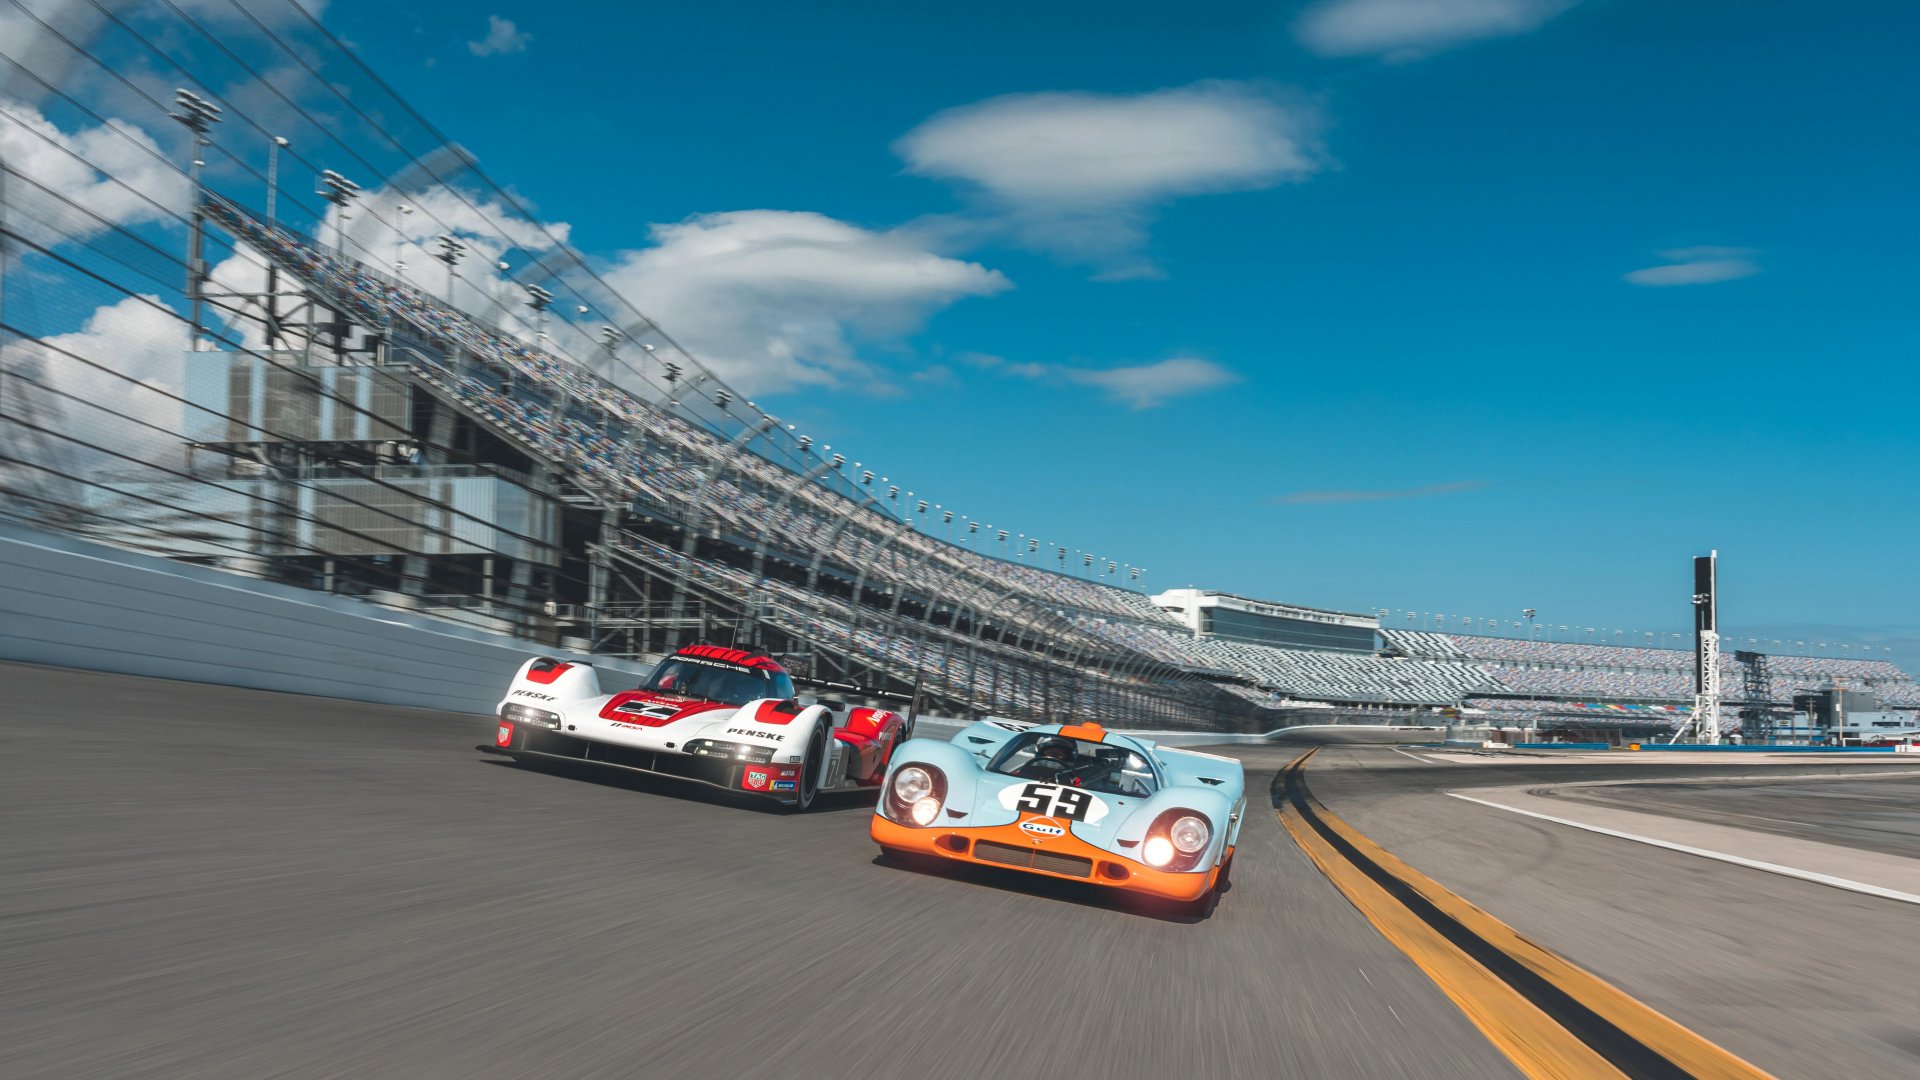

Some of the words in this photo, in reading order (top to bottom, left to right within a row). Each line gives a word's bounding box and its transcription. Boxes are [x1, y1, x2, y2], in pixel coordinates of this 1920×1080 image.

[670, 655, 750, 674] PORSCHE
[512, 689, 558, 702] PENSKE
[726, 728, 785, 742] PENSKE
[750, 773, 767, 781] TAG
[1016, 783, 1093, 823] 59
[1022, 823, 1063, 835] Gulf
